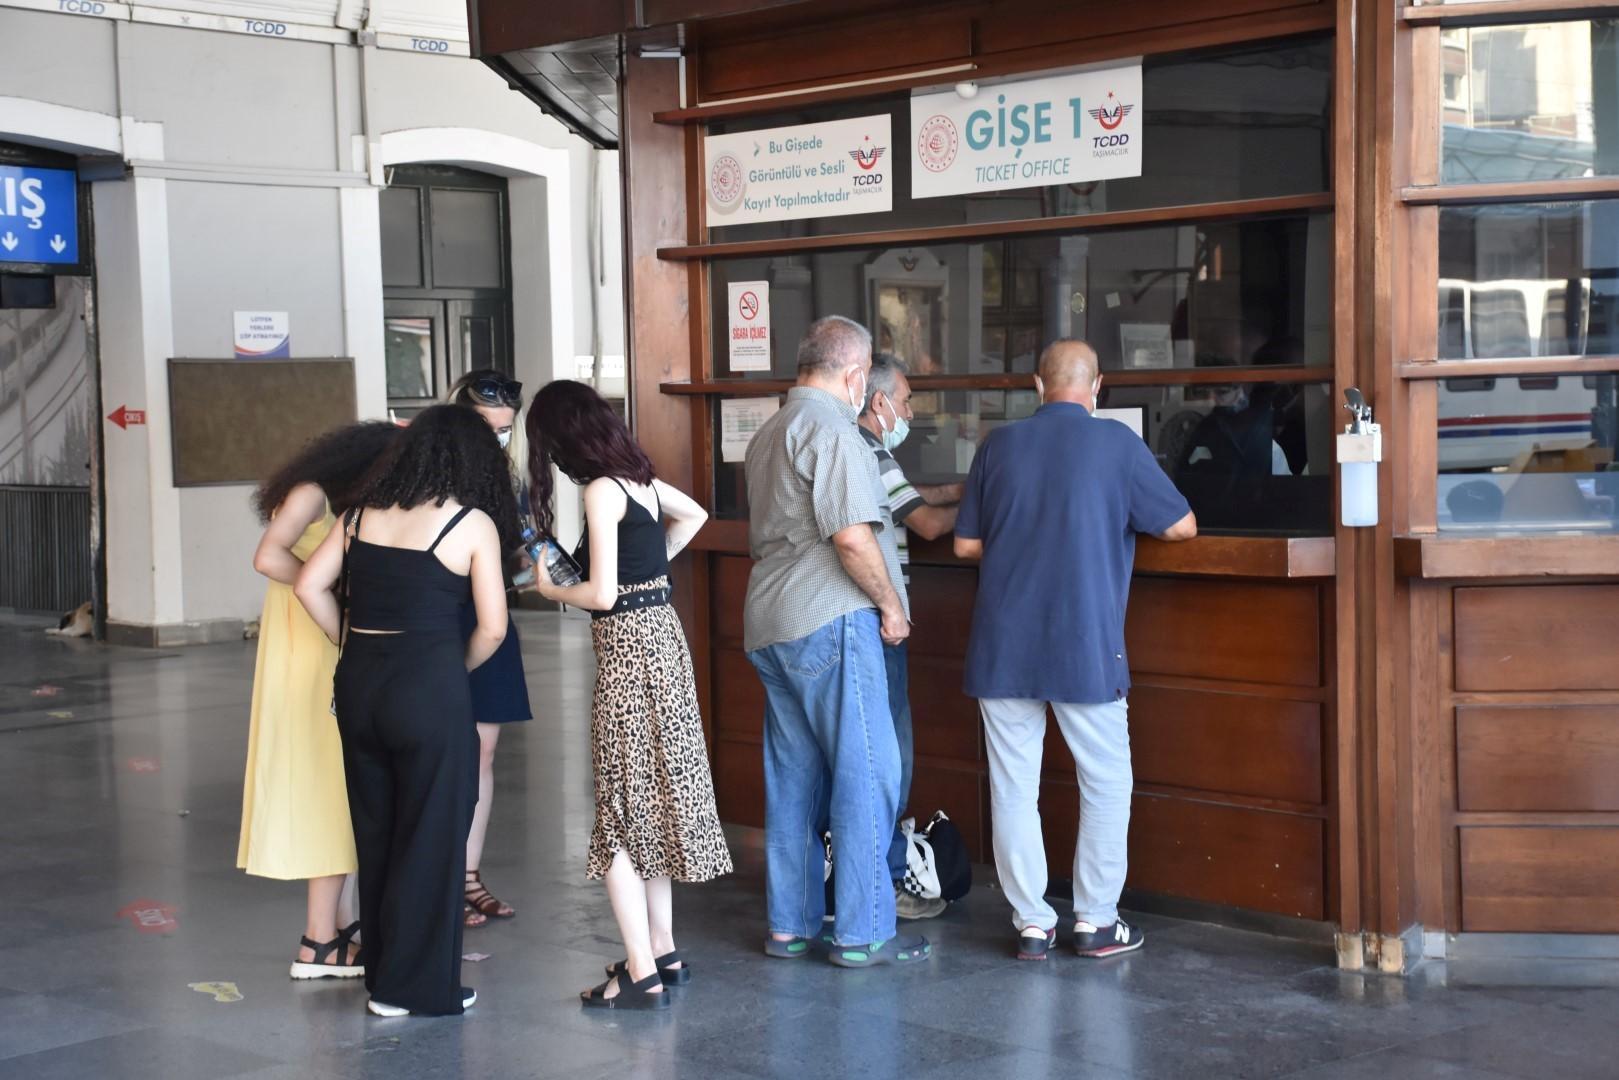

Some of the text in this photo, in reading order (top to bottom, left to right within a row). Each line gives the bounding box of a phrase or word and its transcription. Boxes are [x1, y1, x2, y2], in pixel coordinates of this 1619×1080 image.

[59, 0, 105, 15] TCDD
[245, 20, 287, 35] TCDD
[411, 38, 449, 52] TCDD
[965, 94, 1052, 159] GİŞE
[1068, 97, 1081, 139] 1
[769, 135, 823, 155] Bu Gişede
[1092, 133, 1129, 149] TCDD
[749, 160, 845, 183] Görüntülü ve Sesli
[853, 173, 883, 187] TCDD
[975, 157, 1071, 184] TICKET OFFICE
[0, 177, 46, 230] IŞ
[743, 187, 851, 213] Kayıt Yapılmaktadır
[1114, 923, 1130, 944] N
